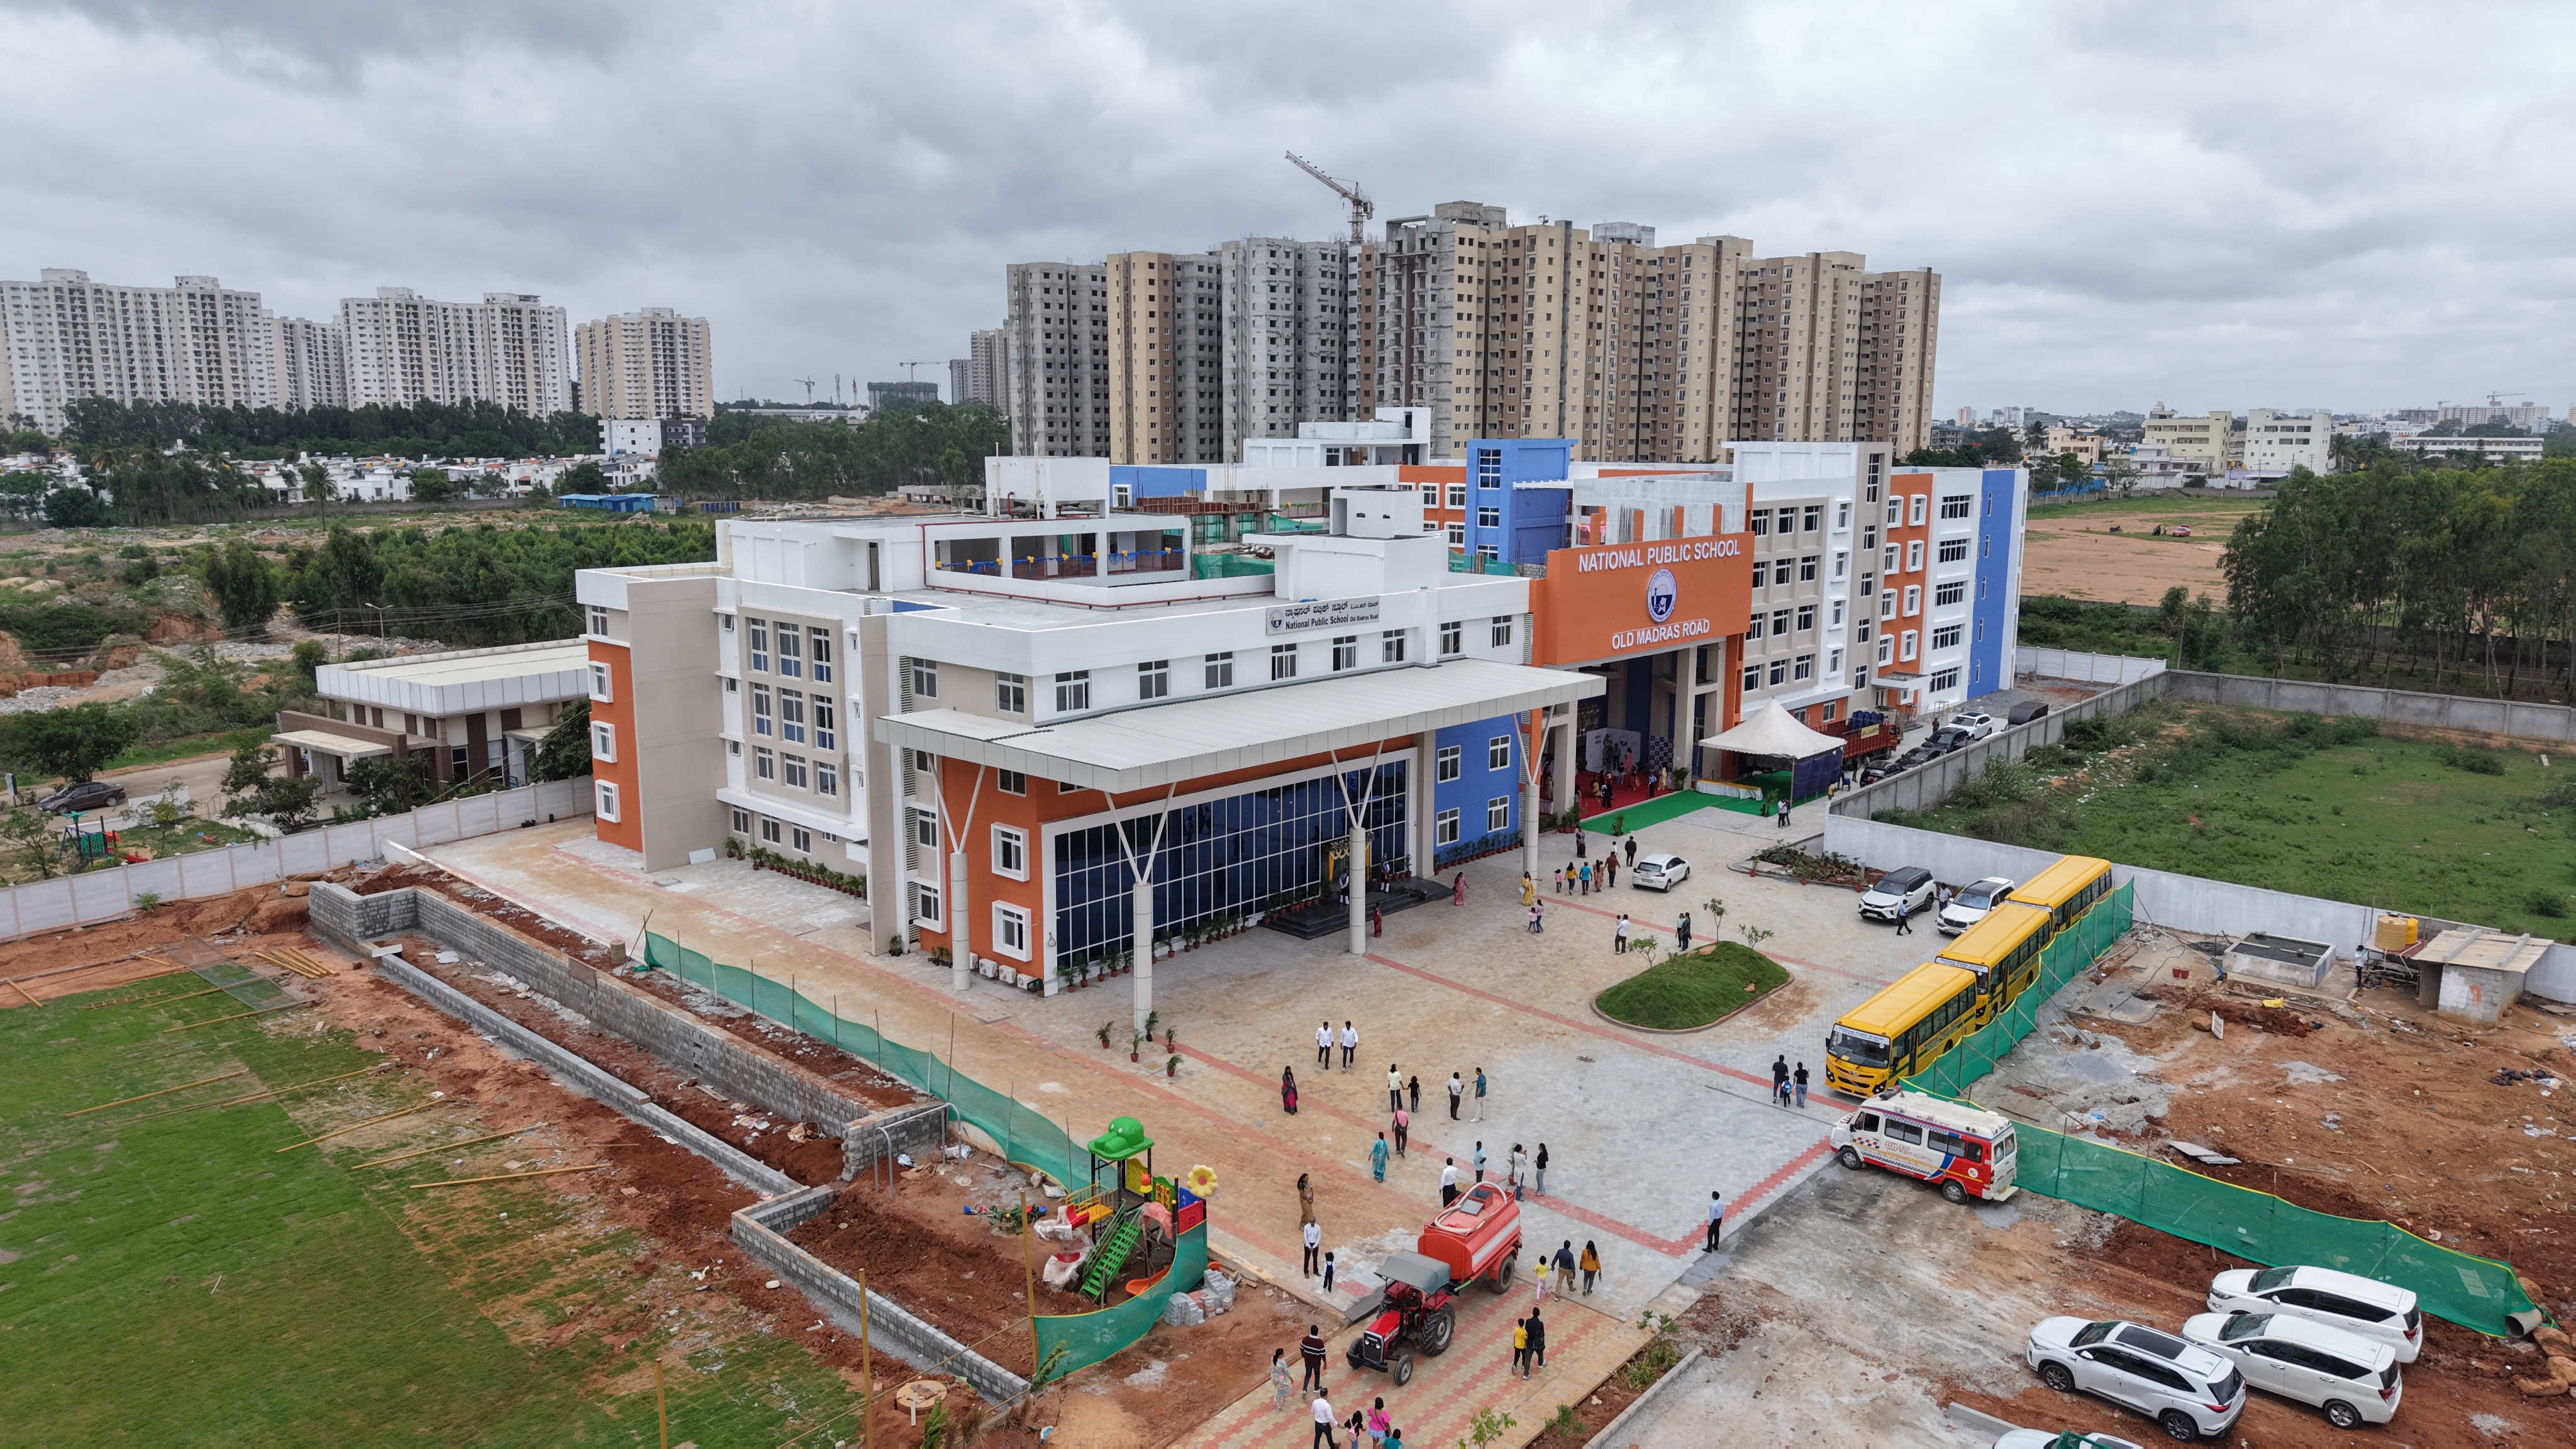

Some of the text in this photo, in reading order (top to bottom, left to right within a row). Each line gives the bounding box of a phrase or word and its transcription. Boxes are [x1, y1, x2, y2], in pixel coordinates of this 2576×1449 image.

[1579, 539, 1741, 572] NATIONAL PUBLIC SCHOOL
[1285, 619, 1309, 630] National
[1311, 617, 1328, 627] Public
[1330, 614, 1348, 625] School
[1612, 619, 1710, 650] OLD MADRAS ROAD
